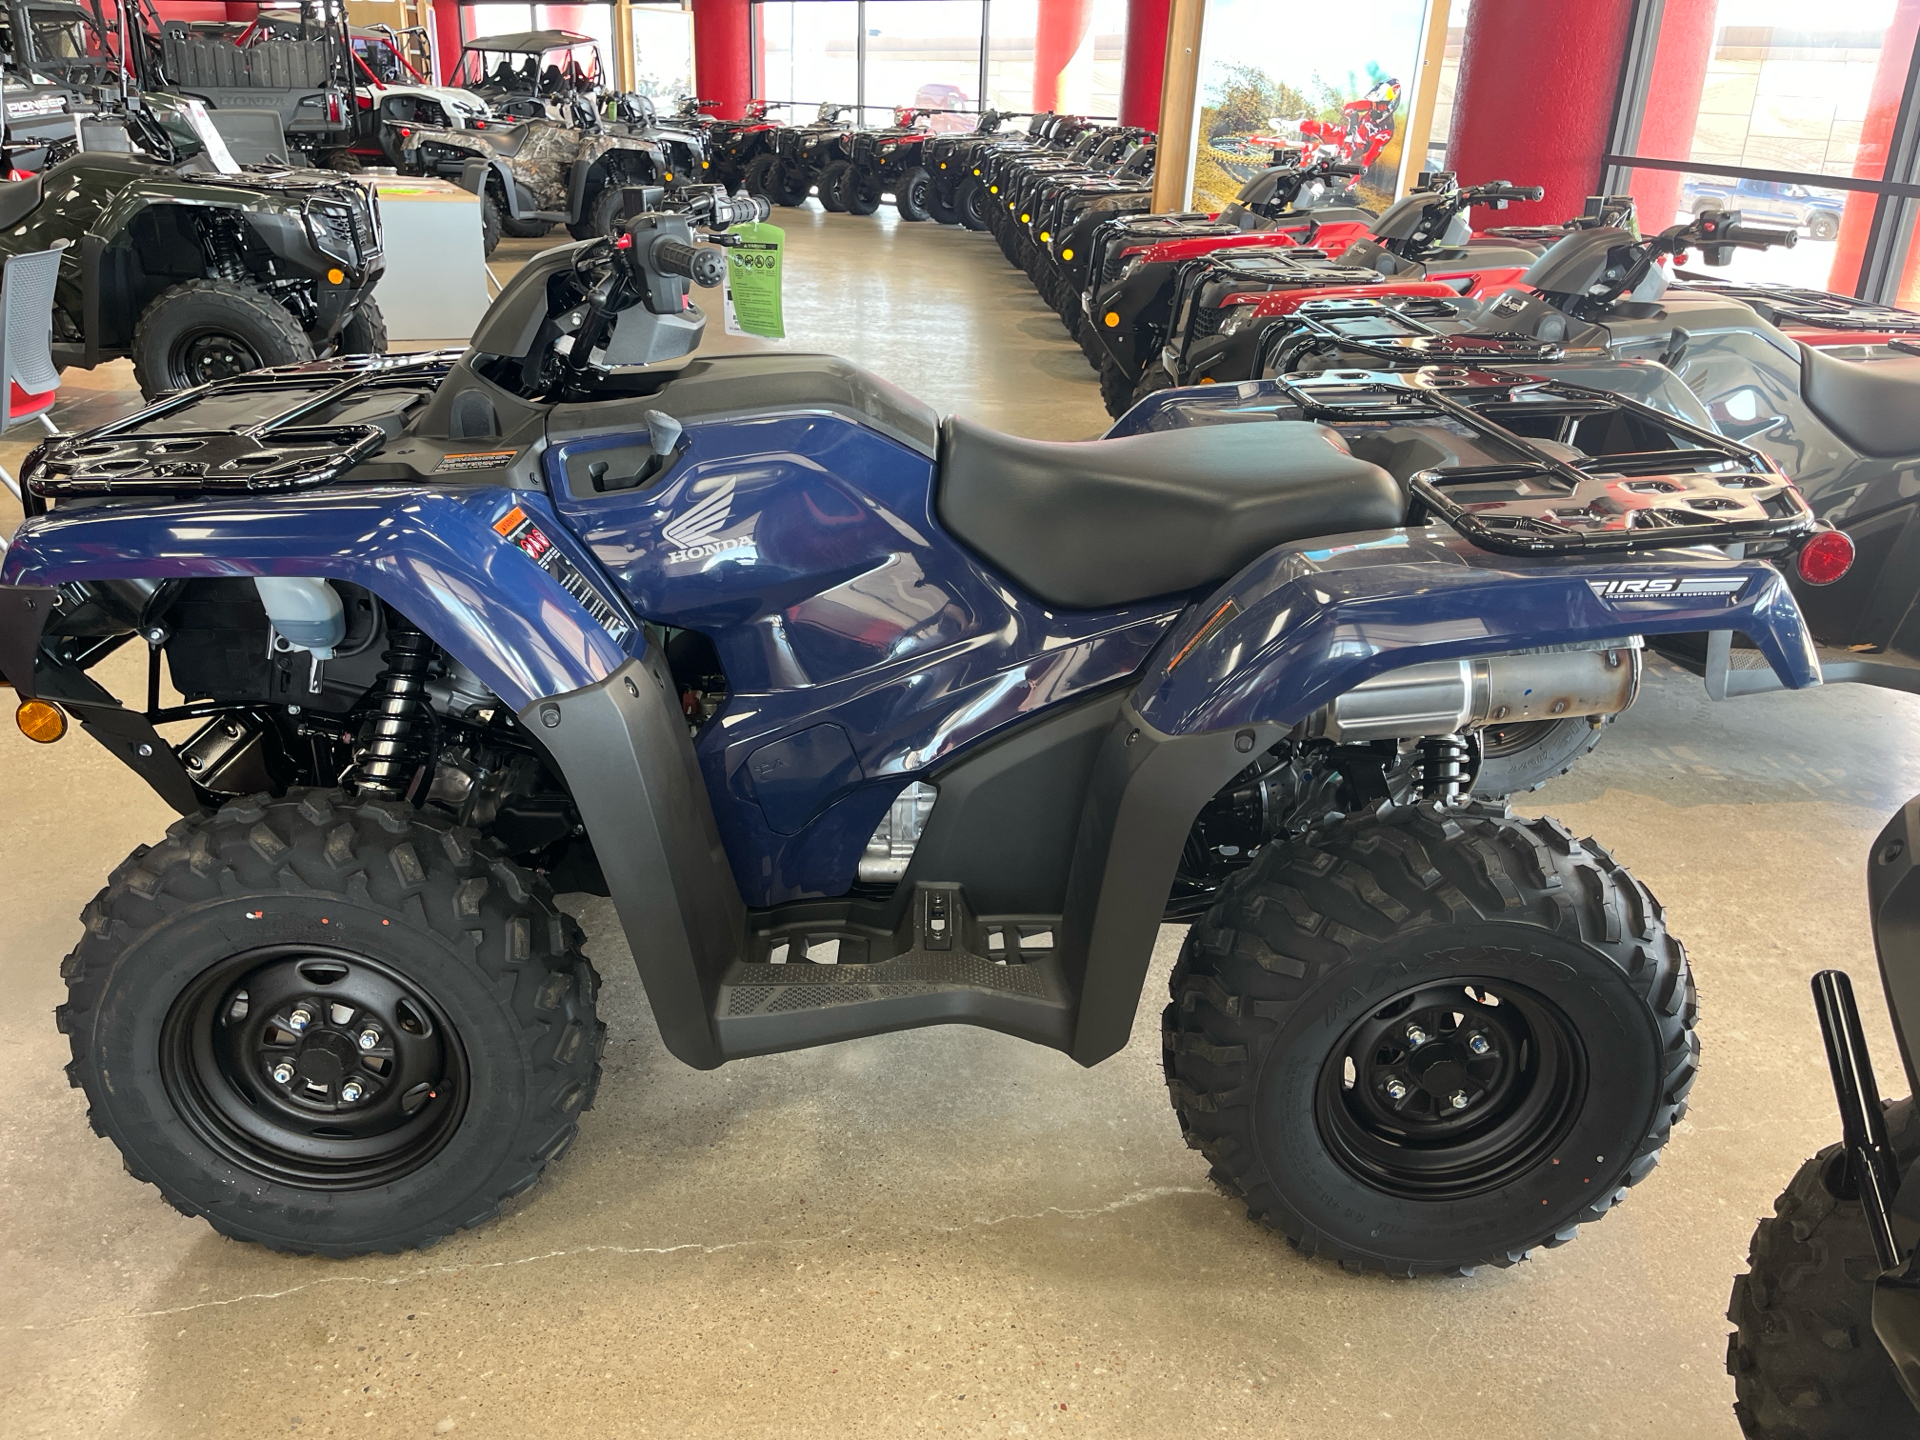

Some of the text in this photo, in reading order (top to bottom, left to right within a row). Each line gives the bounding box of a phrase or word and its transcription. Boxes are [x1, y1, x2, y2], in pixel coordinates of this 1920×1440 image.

[219, 96, 290, 107] HONDA
[668, 535, 756, 564] HONDA
[1605, 578, 1678, 593] IRS
